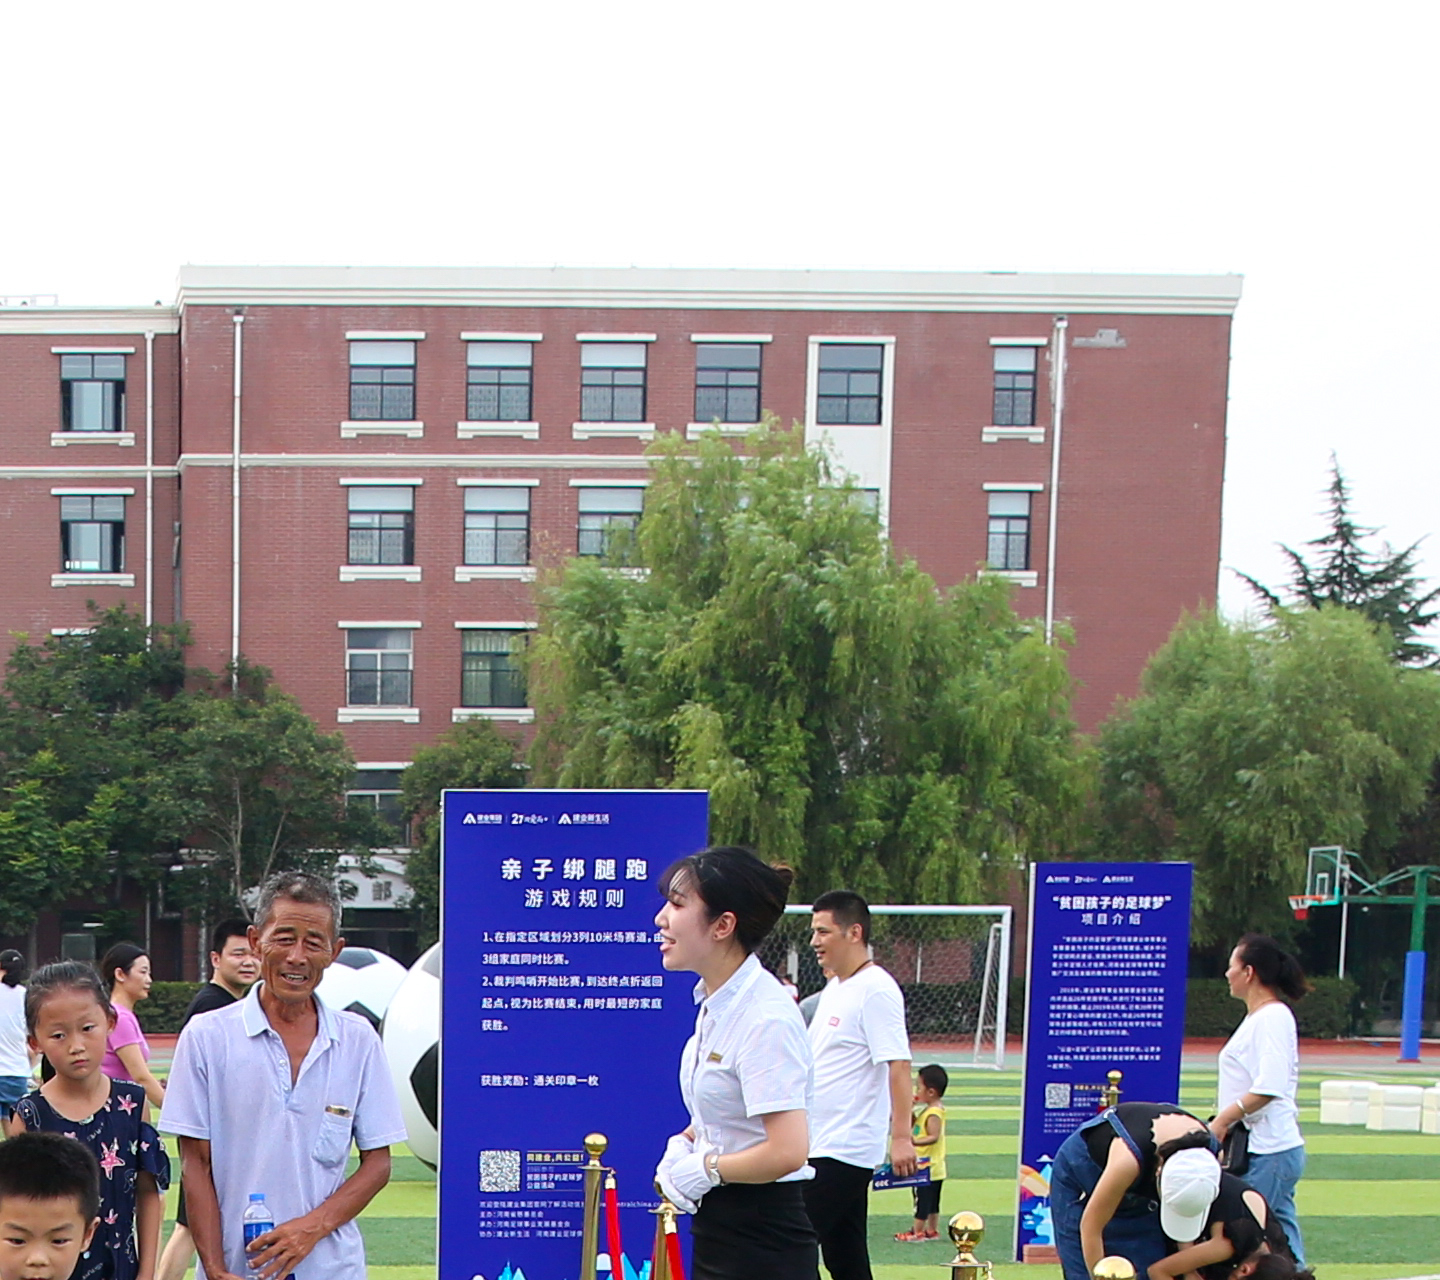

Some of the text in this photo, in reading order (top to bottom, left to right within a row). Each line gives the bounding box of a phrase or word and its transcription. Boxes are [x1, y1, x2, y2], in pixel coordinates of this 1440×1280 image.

[501, 858, 648, 880] 亲子绑腿跑
[524, 888, 625, 908] 游戏规则
[1052, 895, 1172, 910] “贫困孩子的足球梦”
[1081, 912, 1141, 925] 项目介绍
